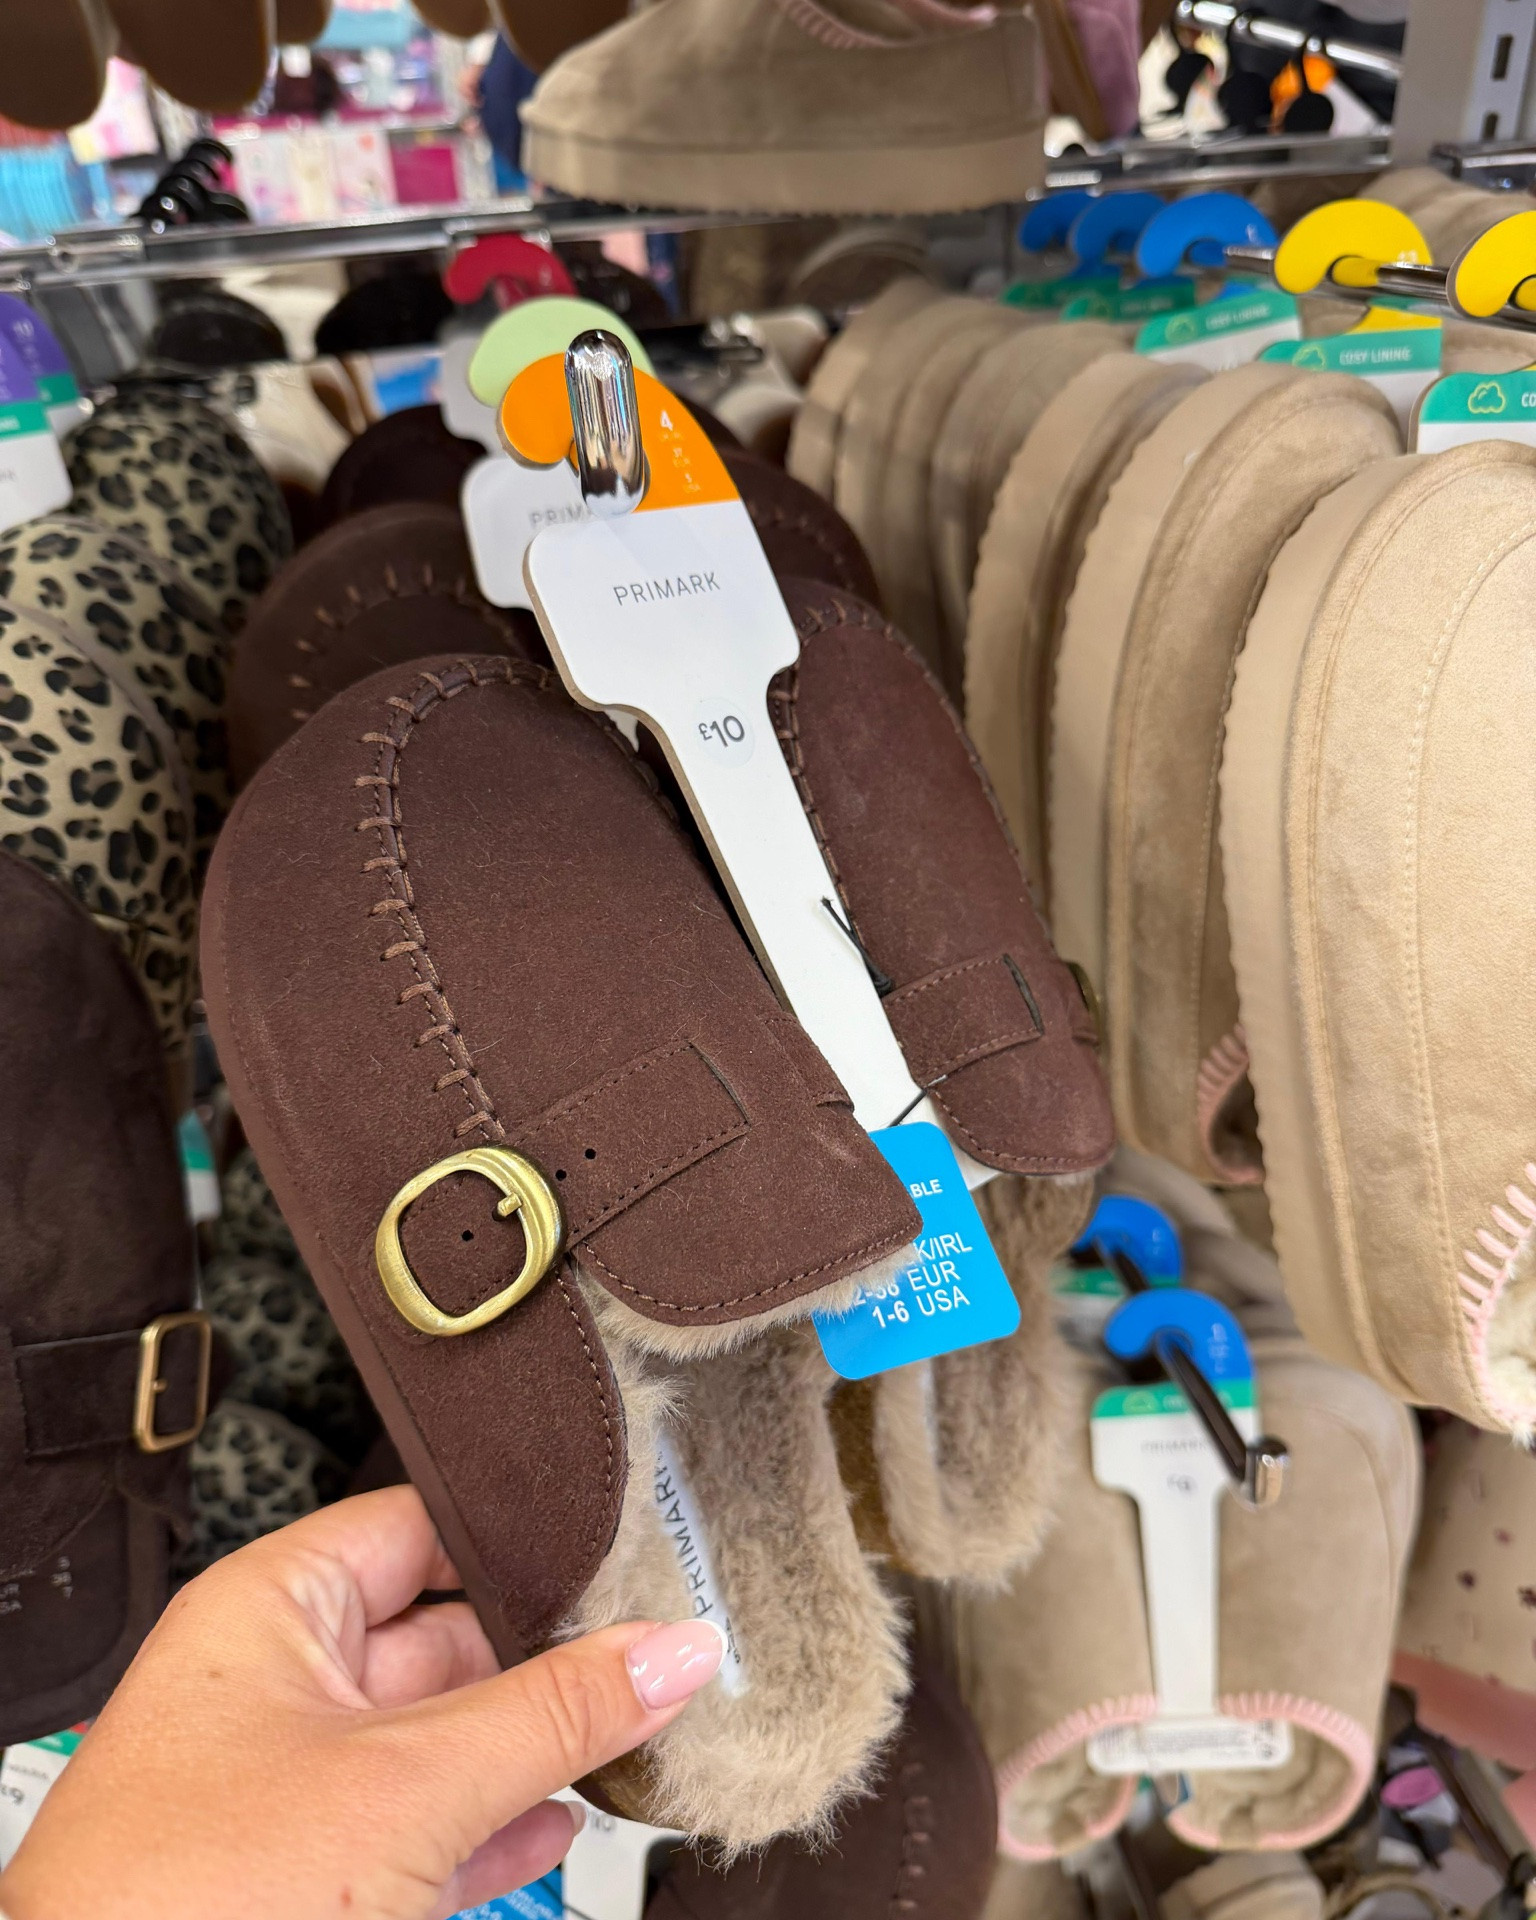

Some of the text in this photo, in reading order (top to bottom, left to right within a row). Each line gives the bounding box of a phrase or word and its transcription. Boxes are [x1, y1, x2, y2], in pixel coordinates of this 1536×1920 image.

[1371, 345, 1411, 363] LINING
[660, 410, 674, 431] 4
[613, 572, 721, 606] PRIMARK
[698, 715, 745, 748] £10
[909, 1178, 943, 1199] BLE
[913, 1231, 973, 1262] K/IRL
[906, 1260, 961, 1291] EUR
[872, 1285, 971, 1328] 1-6 USA
